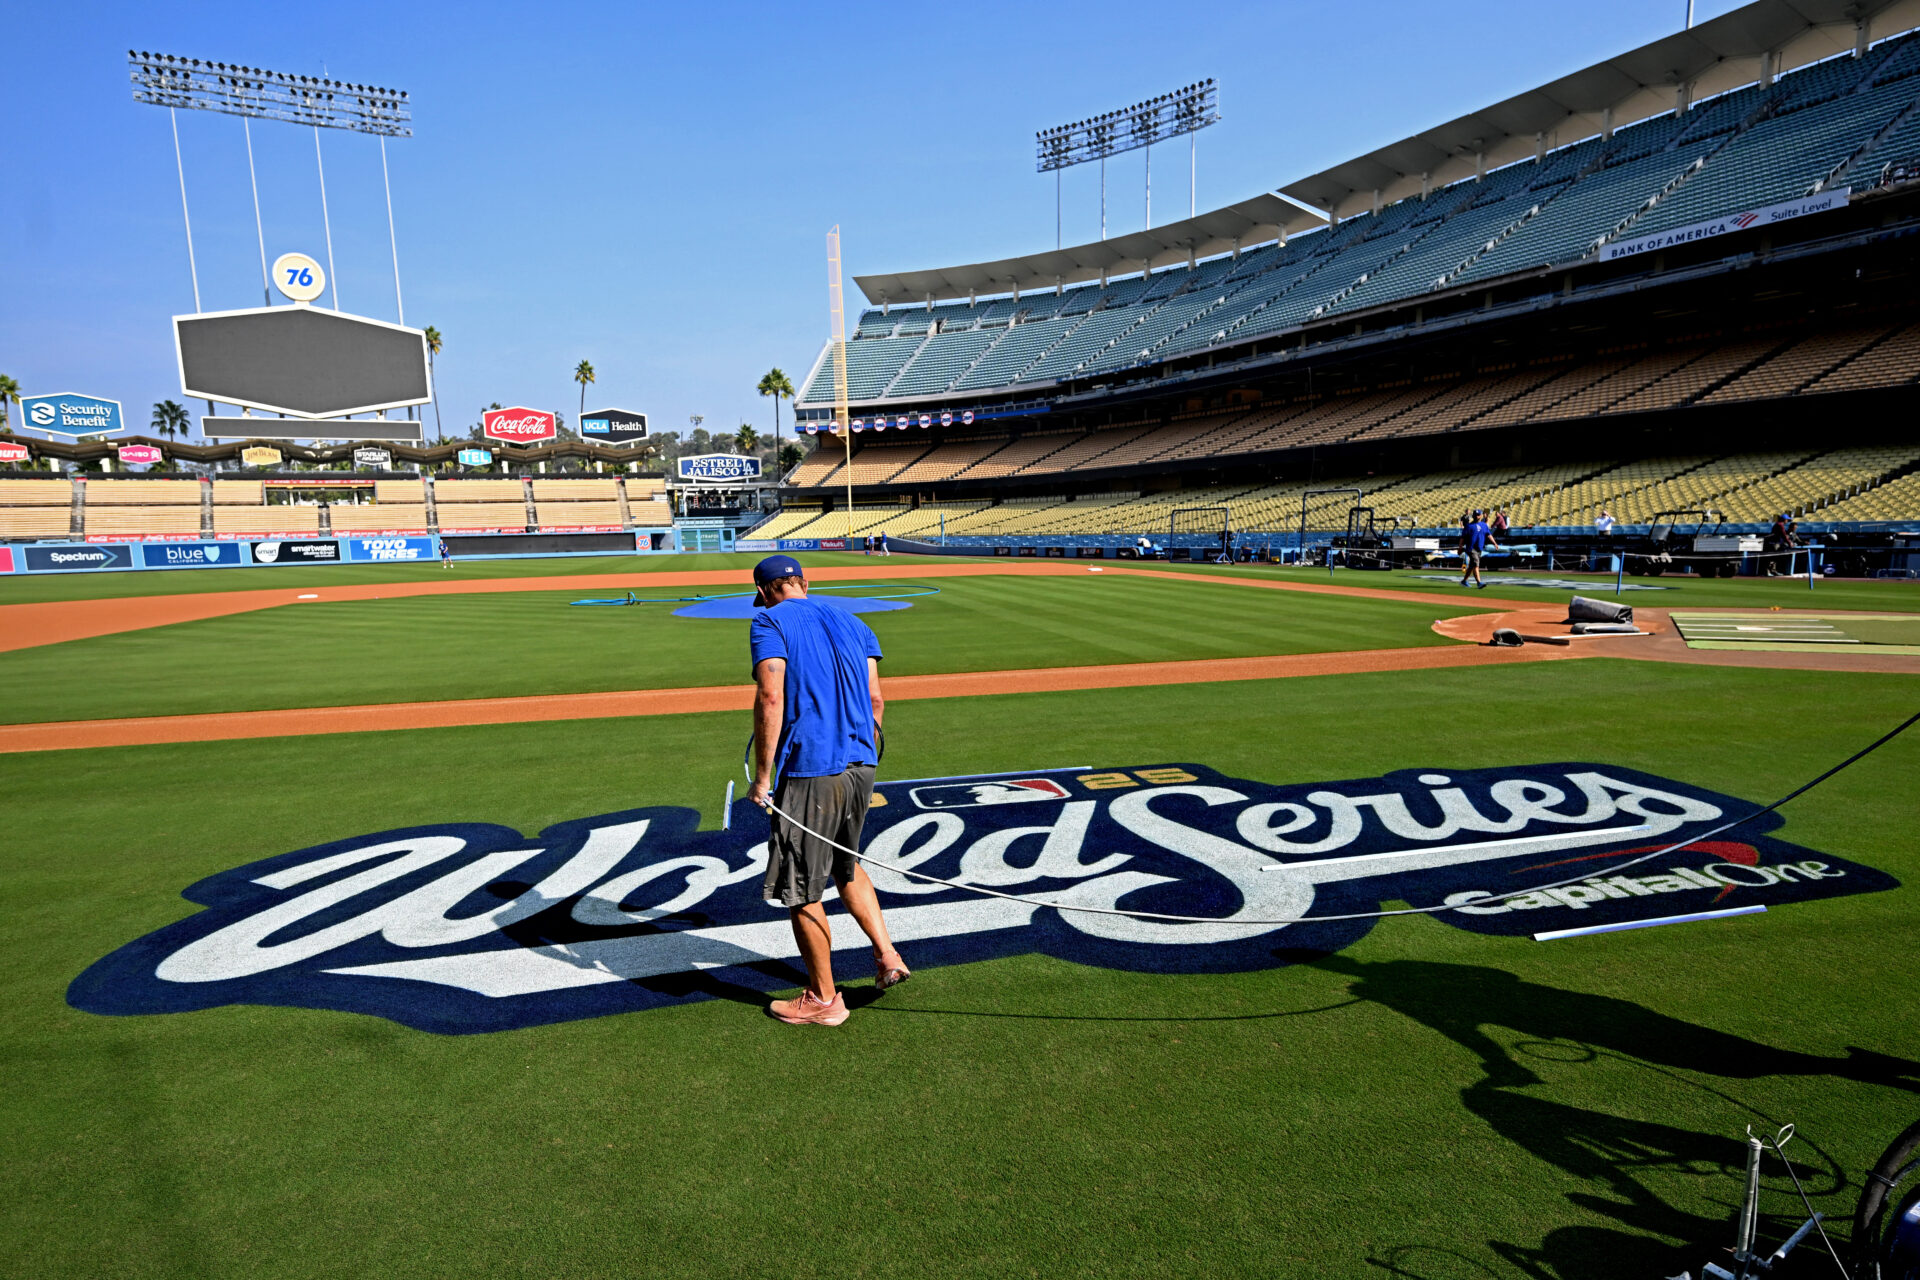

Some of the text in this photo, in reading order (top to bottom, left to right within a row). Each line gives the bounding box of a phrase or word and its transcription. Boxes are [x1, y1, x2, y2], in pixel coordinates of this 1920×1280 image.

[1611, 198, 1832, 258] BANK OF AMERICA Suite Level
[286, 268, 313, 287] 76
[59, 403, 112, 417] Security
[61, 415, 108, 427] Benefit
[490, 415, 548, 435] Coca-Cola
[584, 420, 643, 431] UCLA Health
[463, 452, 490, 463] TEL
[686, 468, 740, 476] JALISCO
[361, 539, 407, 550] TOYO
[638, 538, 649, 546] 76
[50, 552, 104, 563] Spectrum
[166, 547, 204, 559] blue
[370, 548, 419, 559] TIRES
[1076, 767, 1199, 790] 25
[1052, 771, 1722, 945] Series
[1444, 860, 1846, 916] Capital One
